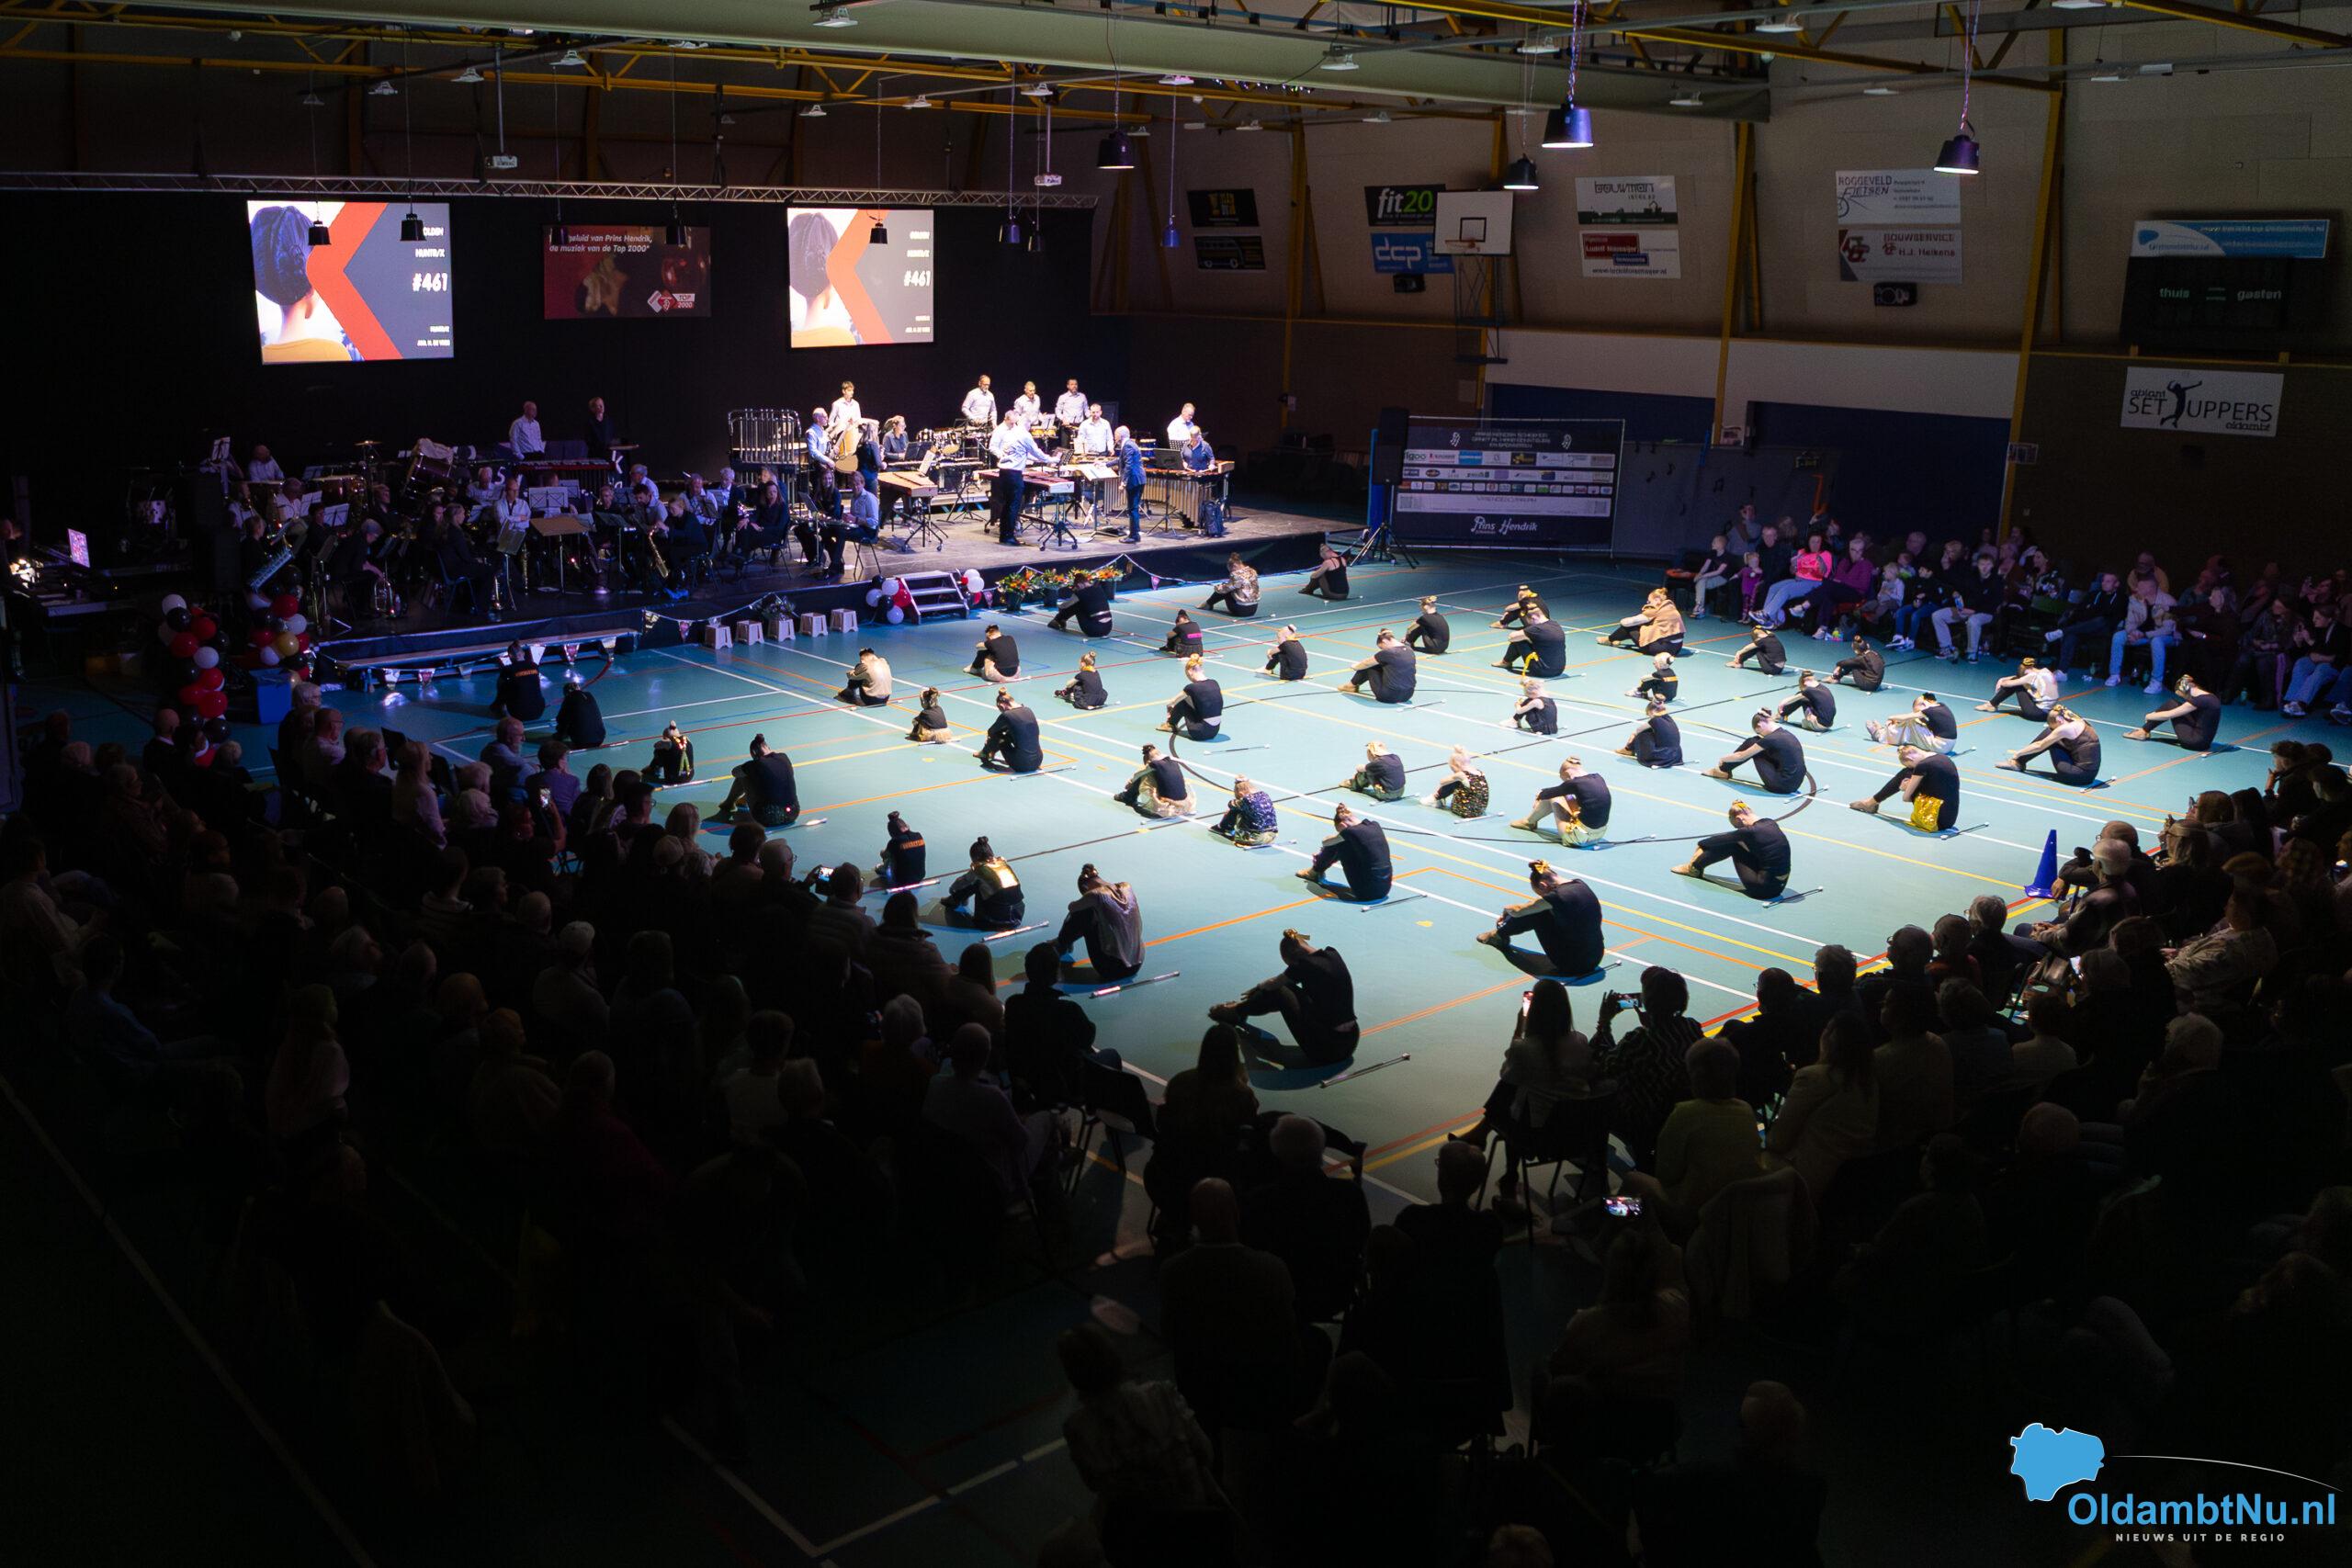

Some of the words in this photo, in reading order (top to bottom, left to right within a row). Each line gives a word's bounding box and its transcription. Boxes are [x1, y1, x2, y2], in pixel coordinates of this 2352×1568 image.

[1594, 181, 1655, 194] bouwman
[1838, 175, 1893, 186] ROGGEVELD
[1377, 187, 1434, 220] fit20
[422, 227, 445, 237] OLDEN
[605, 234, 623, 243] Prins
[1883, 233, 1955, 243] BOUWSERVICE
[548, 244, 559, 253] de
[560, 244, 586, 253] muziek
[602, 244, 612, 253] de
[613, 244, 627, 254] Top
[1374, 236, 1422, 270] dcp
[413, 272, 448, 292] #461
[904, 270, 931, 288] #461
[2159, 287, 2191, 299] thuis
[2236, 289, 2282, 301] gasten
[2128, 397, 2167, 415] SET
[2187, 400, 2274, 423] UPPERS
[1470, 515, 1497, 533] Prins
[1498, 517, 1538, 536] Hendrik
